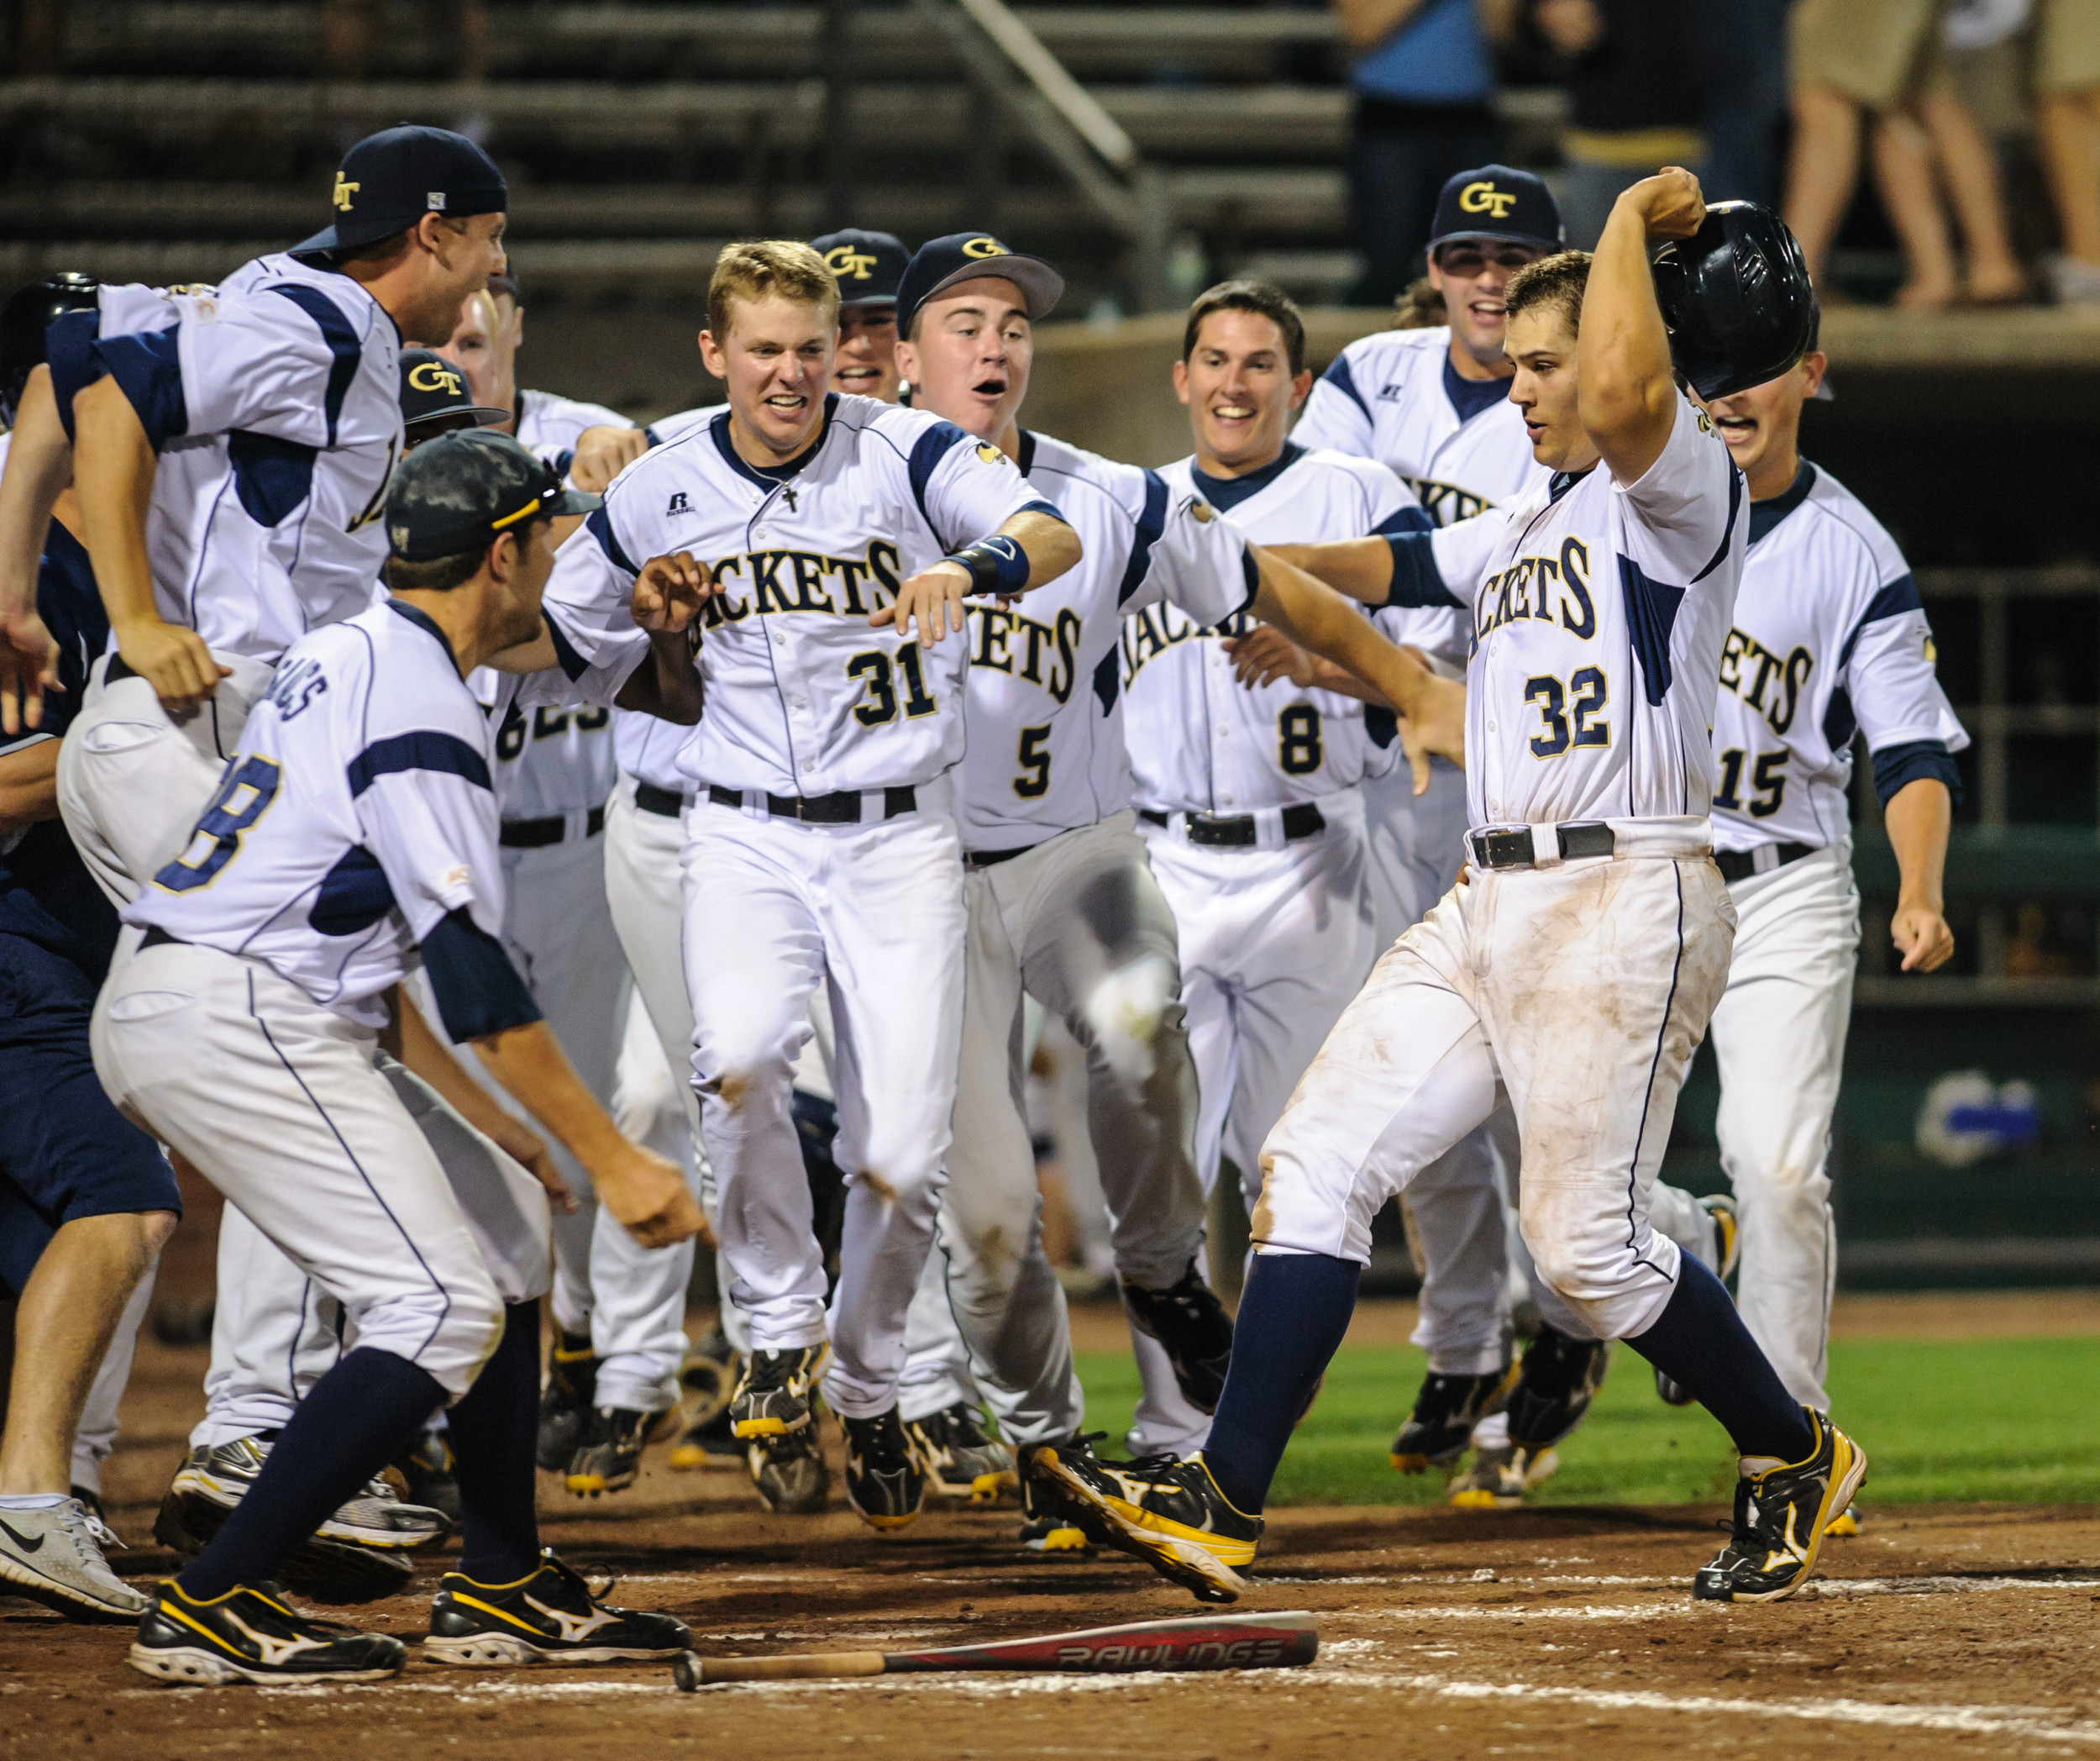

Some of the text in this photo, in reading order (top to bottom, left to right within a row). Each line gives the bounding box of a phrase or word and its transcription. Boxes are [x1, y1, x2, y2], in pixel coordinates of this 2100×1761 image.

[1459, 181, 1517, 218] GT
[823, 244, 877, 280] GT
[408, 360, 462, 396] GT
[690, 539, 917, 660] CKETS
[845, 640, 938, 728] 31
[963, 603, 1083, 706] ETS
[1277, 703, 1324, 777] 8
[1525, 664, 1612, 761] 32
[1011, 722, 1052, 800] 5
[1712, 746, 1791, 820] 15
[150, 751, 285, 897] 8
[1057, 1638, 1284, 1666] RAWLINGS
